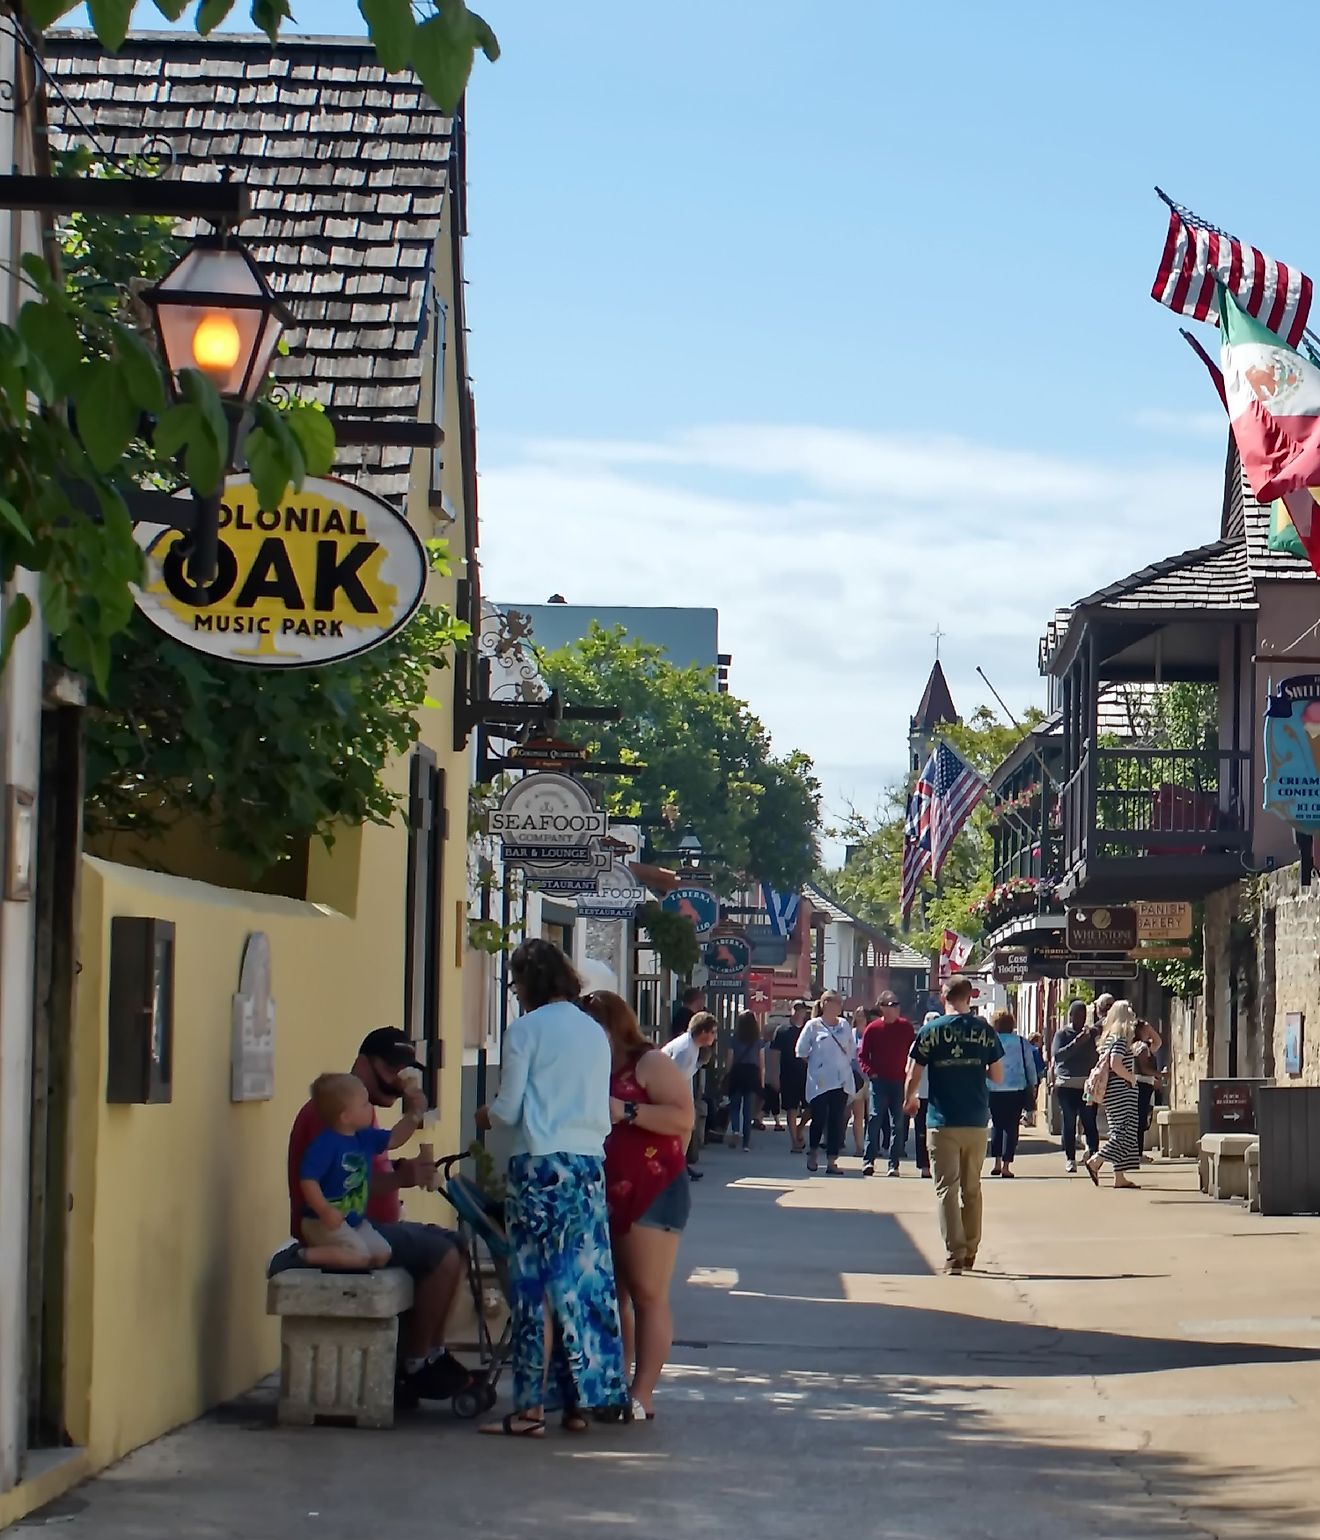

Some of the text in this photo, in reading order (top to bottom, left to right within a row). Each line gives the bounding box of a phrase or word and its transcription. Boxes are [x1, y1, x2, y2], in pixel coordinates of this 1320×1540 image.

[217, 504, 367, 536] OLONIAL
[163, 537, 380, 614] OAK
[194, 614, 344, 638] MUSIC PARK
[1284, 684, 1320, 700] SWEET
[492, 813, 601, 832] SEAFOOD
[518, 833, 574, 843] COMPANY
[505, 849, 588, 859] BAR & LOUNGE
[527, 879, 596, 890] RSTAURANT
[1140, 903, 1187, 916] PANISH
